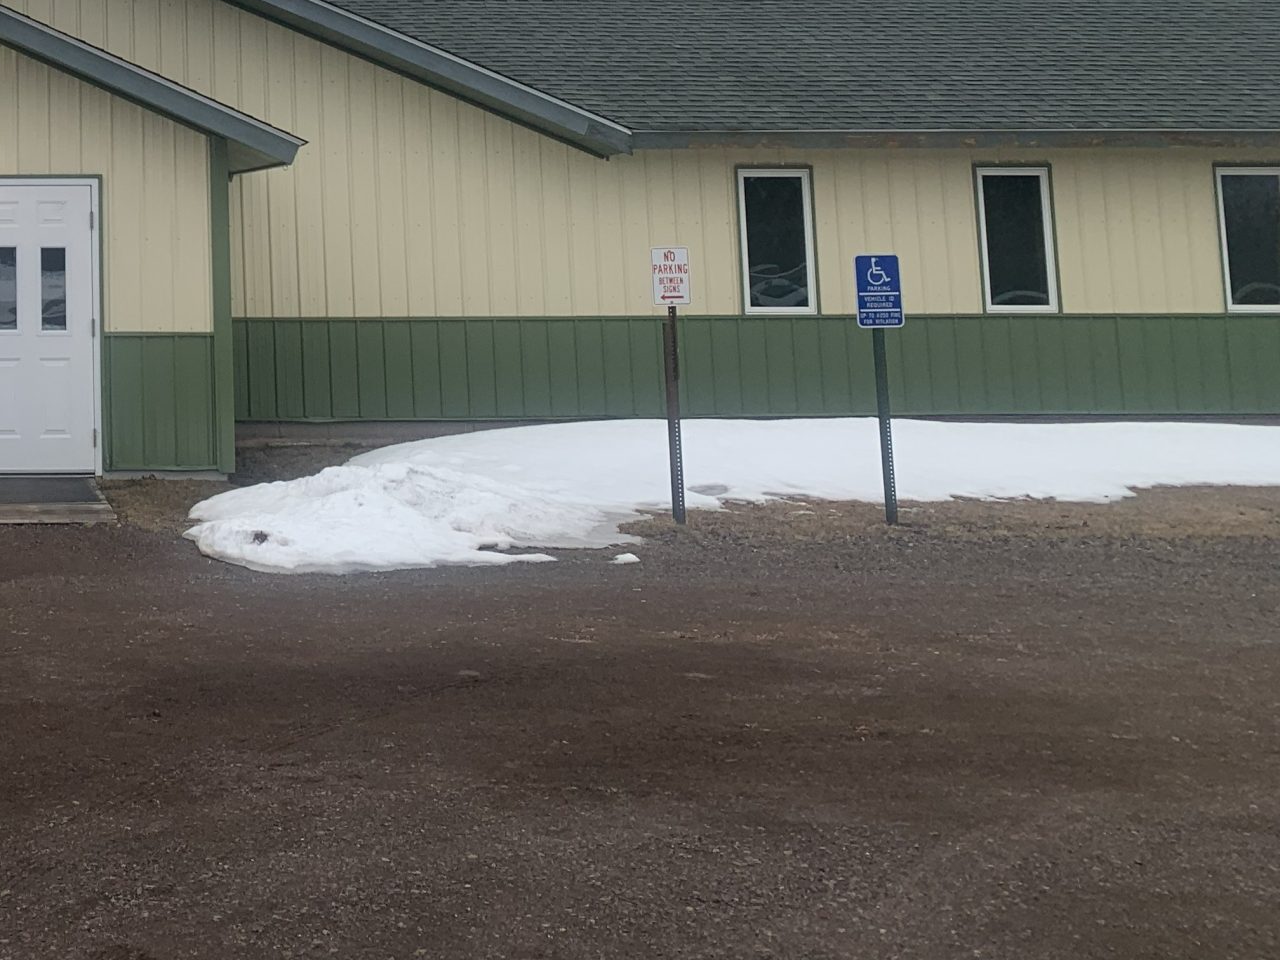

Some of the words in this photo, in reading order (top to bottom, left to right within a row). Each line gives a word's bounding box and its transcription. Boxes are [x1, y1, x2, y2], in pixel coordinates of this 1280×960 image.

[663, 251, 675, 262] NO
[652, 263, 688, 275] PARKING
[658, 276, 684, 285] BETWEEN
[662, 285, 681, 293] SIGNS
